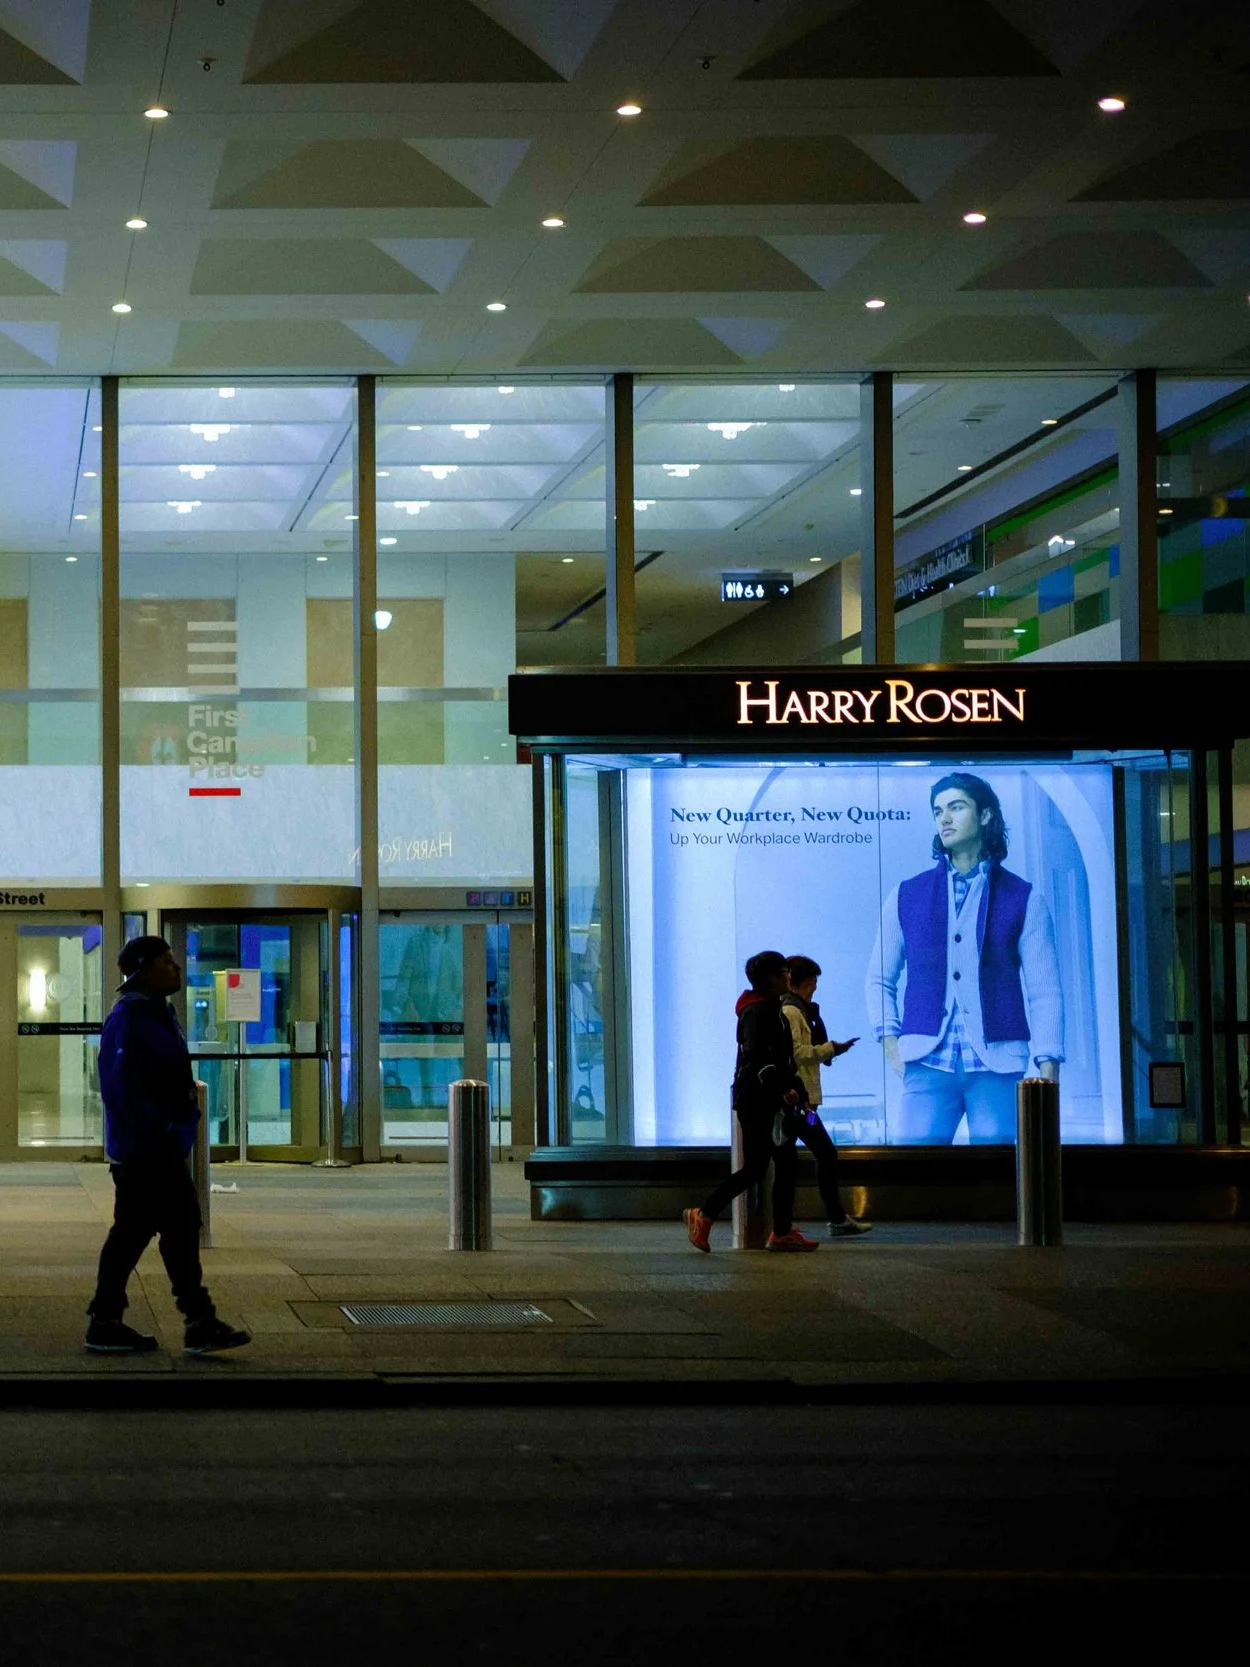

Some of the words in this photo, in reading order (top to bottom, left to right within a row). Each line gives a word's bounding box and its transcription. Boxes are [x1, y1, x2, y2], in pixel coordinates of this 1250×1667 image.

[736, 680, 882, 724] HARRY
[884, 680, 1026, 723] ROSEN
[188, 705, 248, 728] First
[188, 756, 266, 779] Place
[669, 807, 712, 823] New
[716, 807, 796, 826] Quarter,
[801, 806, 843, 822] New
[847, 806, 912, 825] Quota:
[670, 833, 690, 847] Up
[693, 832, 723, 845] Your
[726, 832, 801, 847] Workplace
[804, 831, 873, 845] Wardrobe
